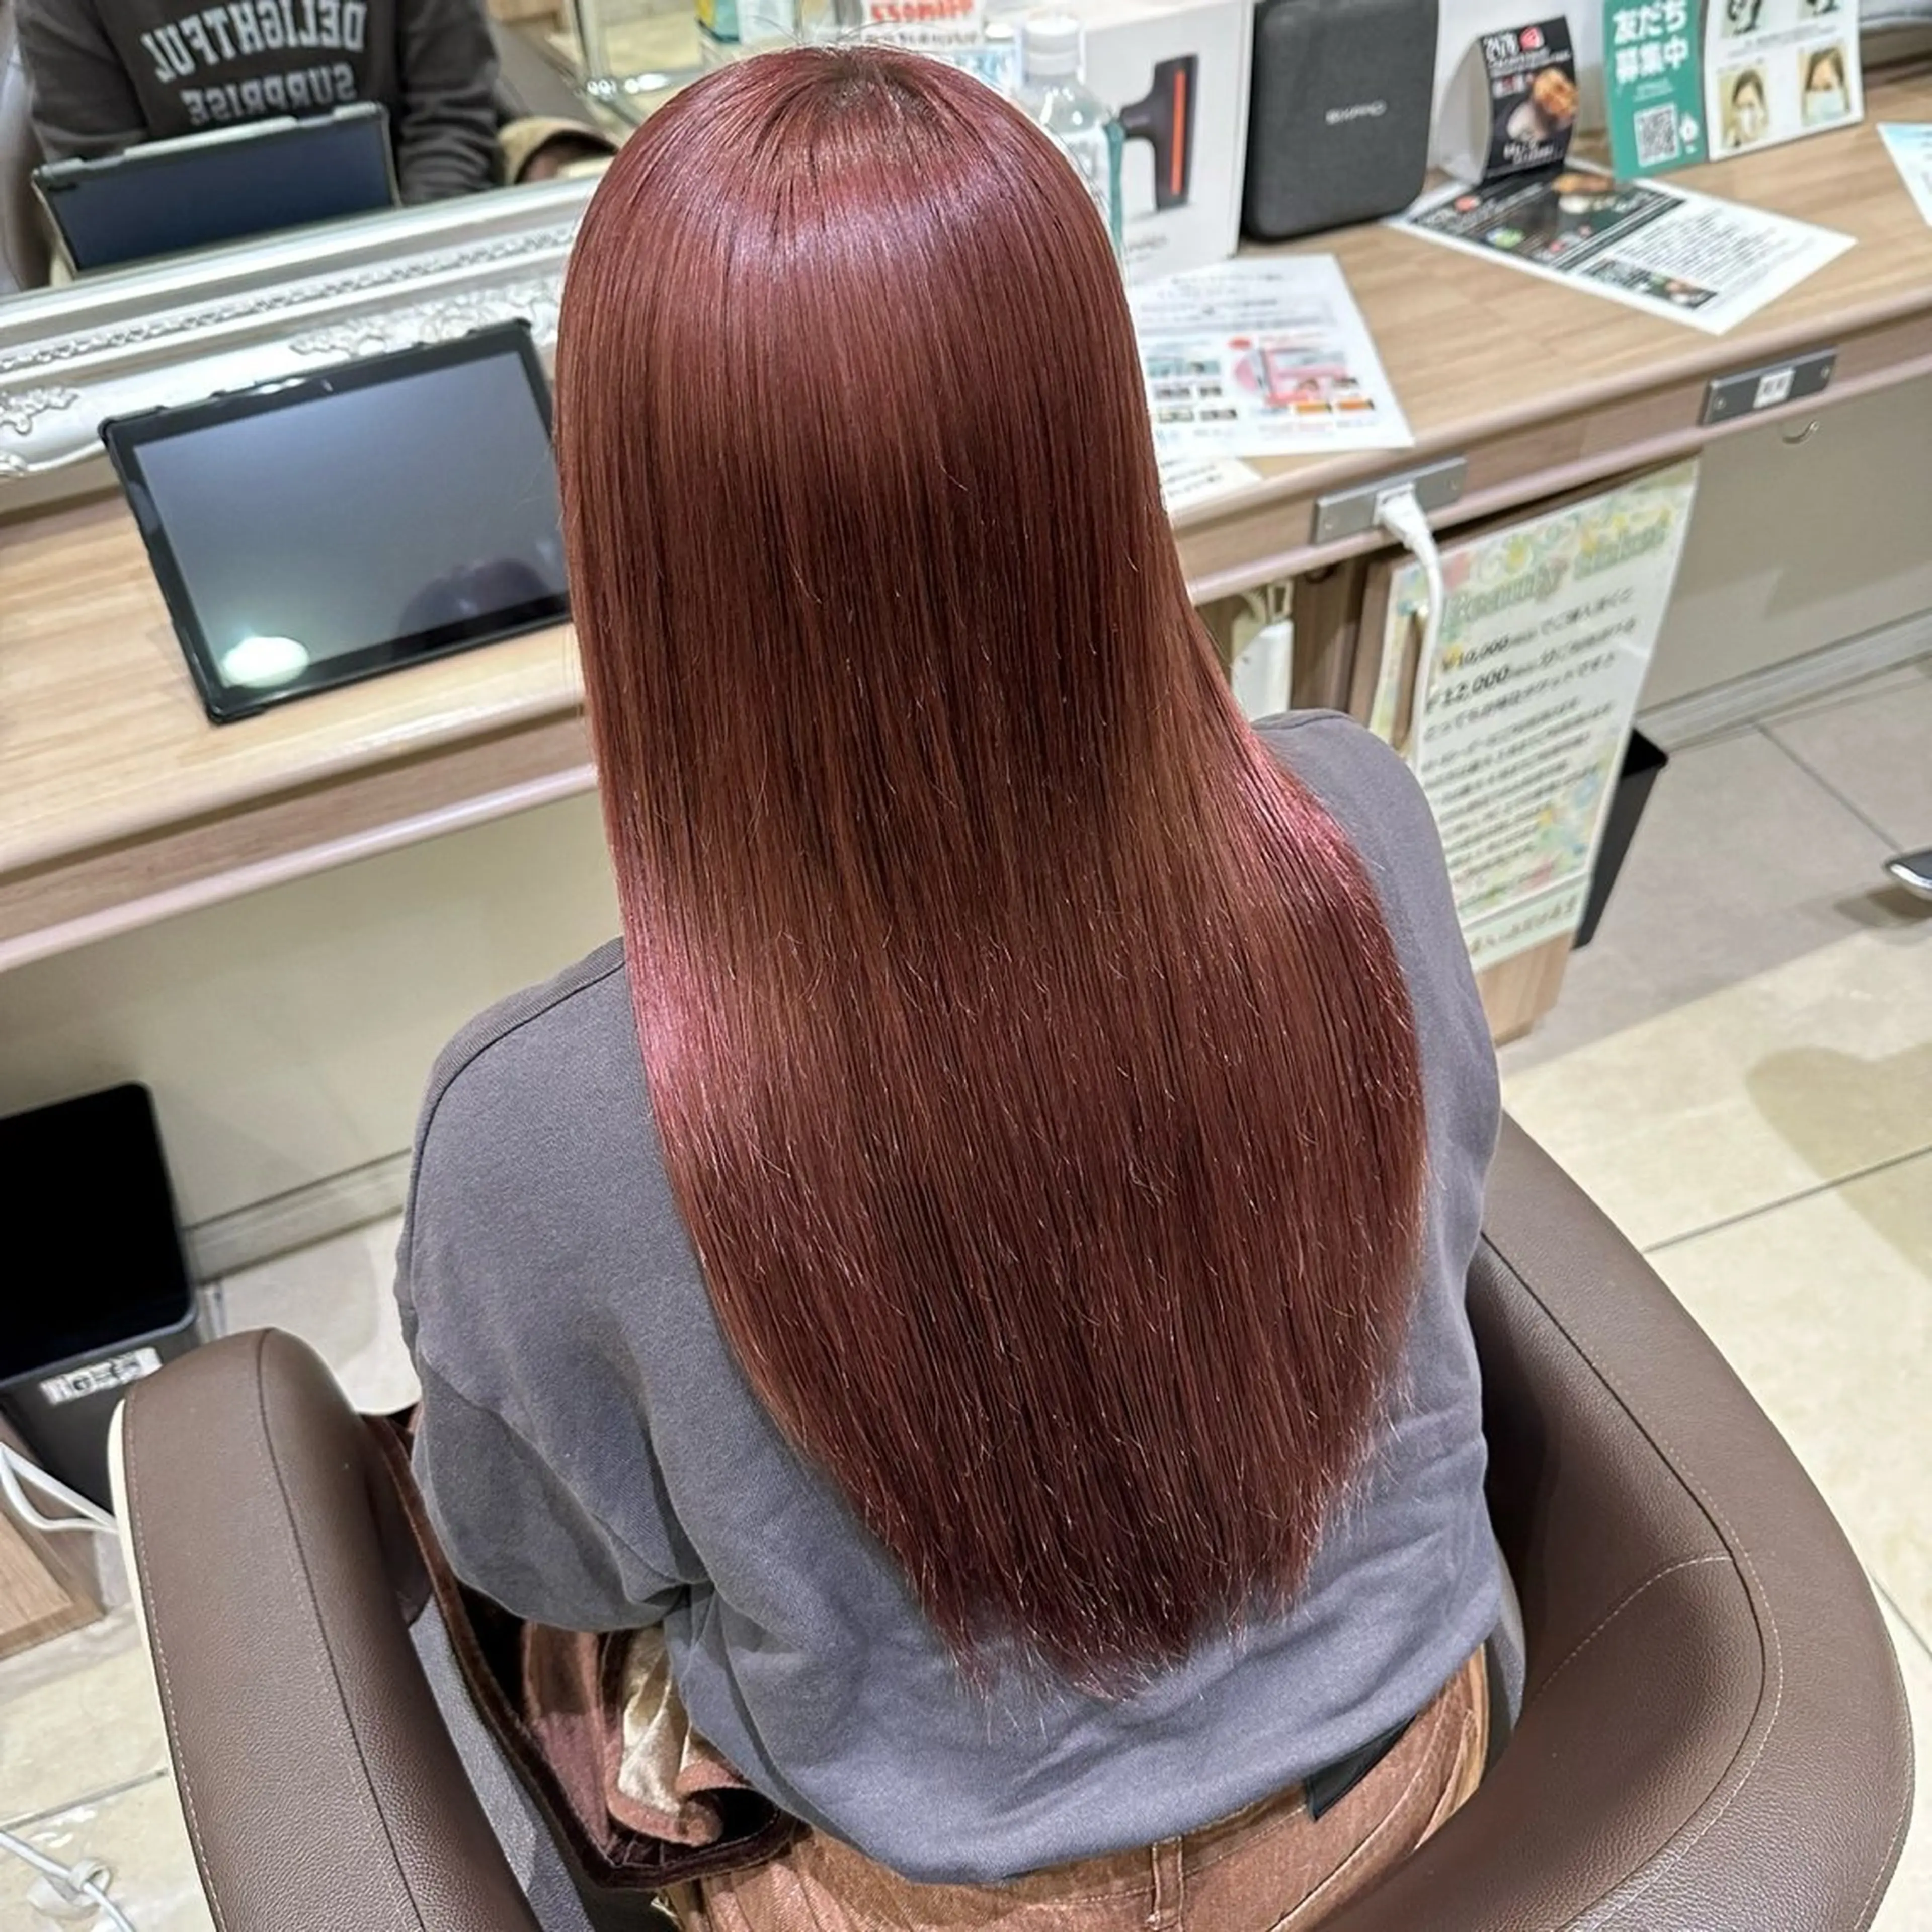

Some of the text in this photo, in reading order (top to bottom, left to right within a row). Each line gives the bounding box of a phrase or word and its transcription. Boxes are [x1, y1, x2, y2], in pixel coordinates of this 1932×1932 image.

[1613, 0, 1687, 45] 友だち
[1615, 34, 1689, 85] 募集中
